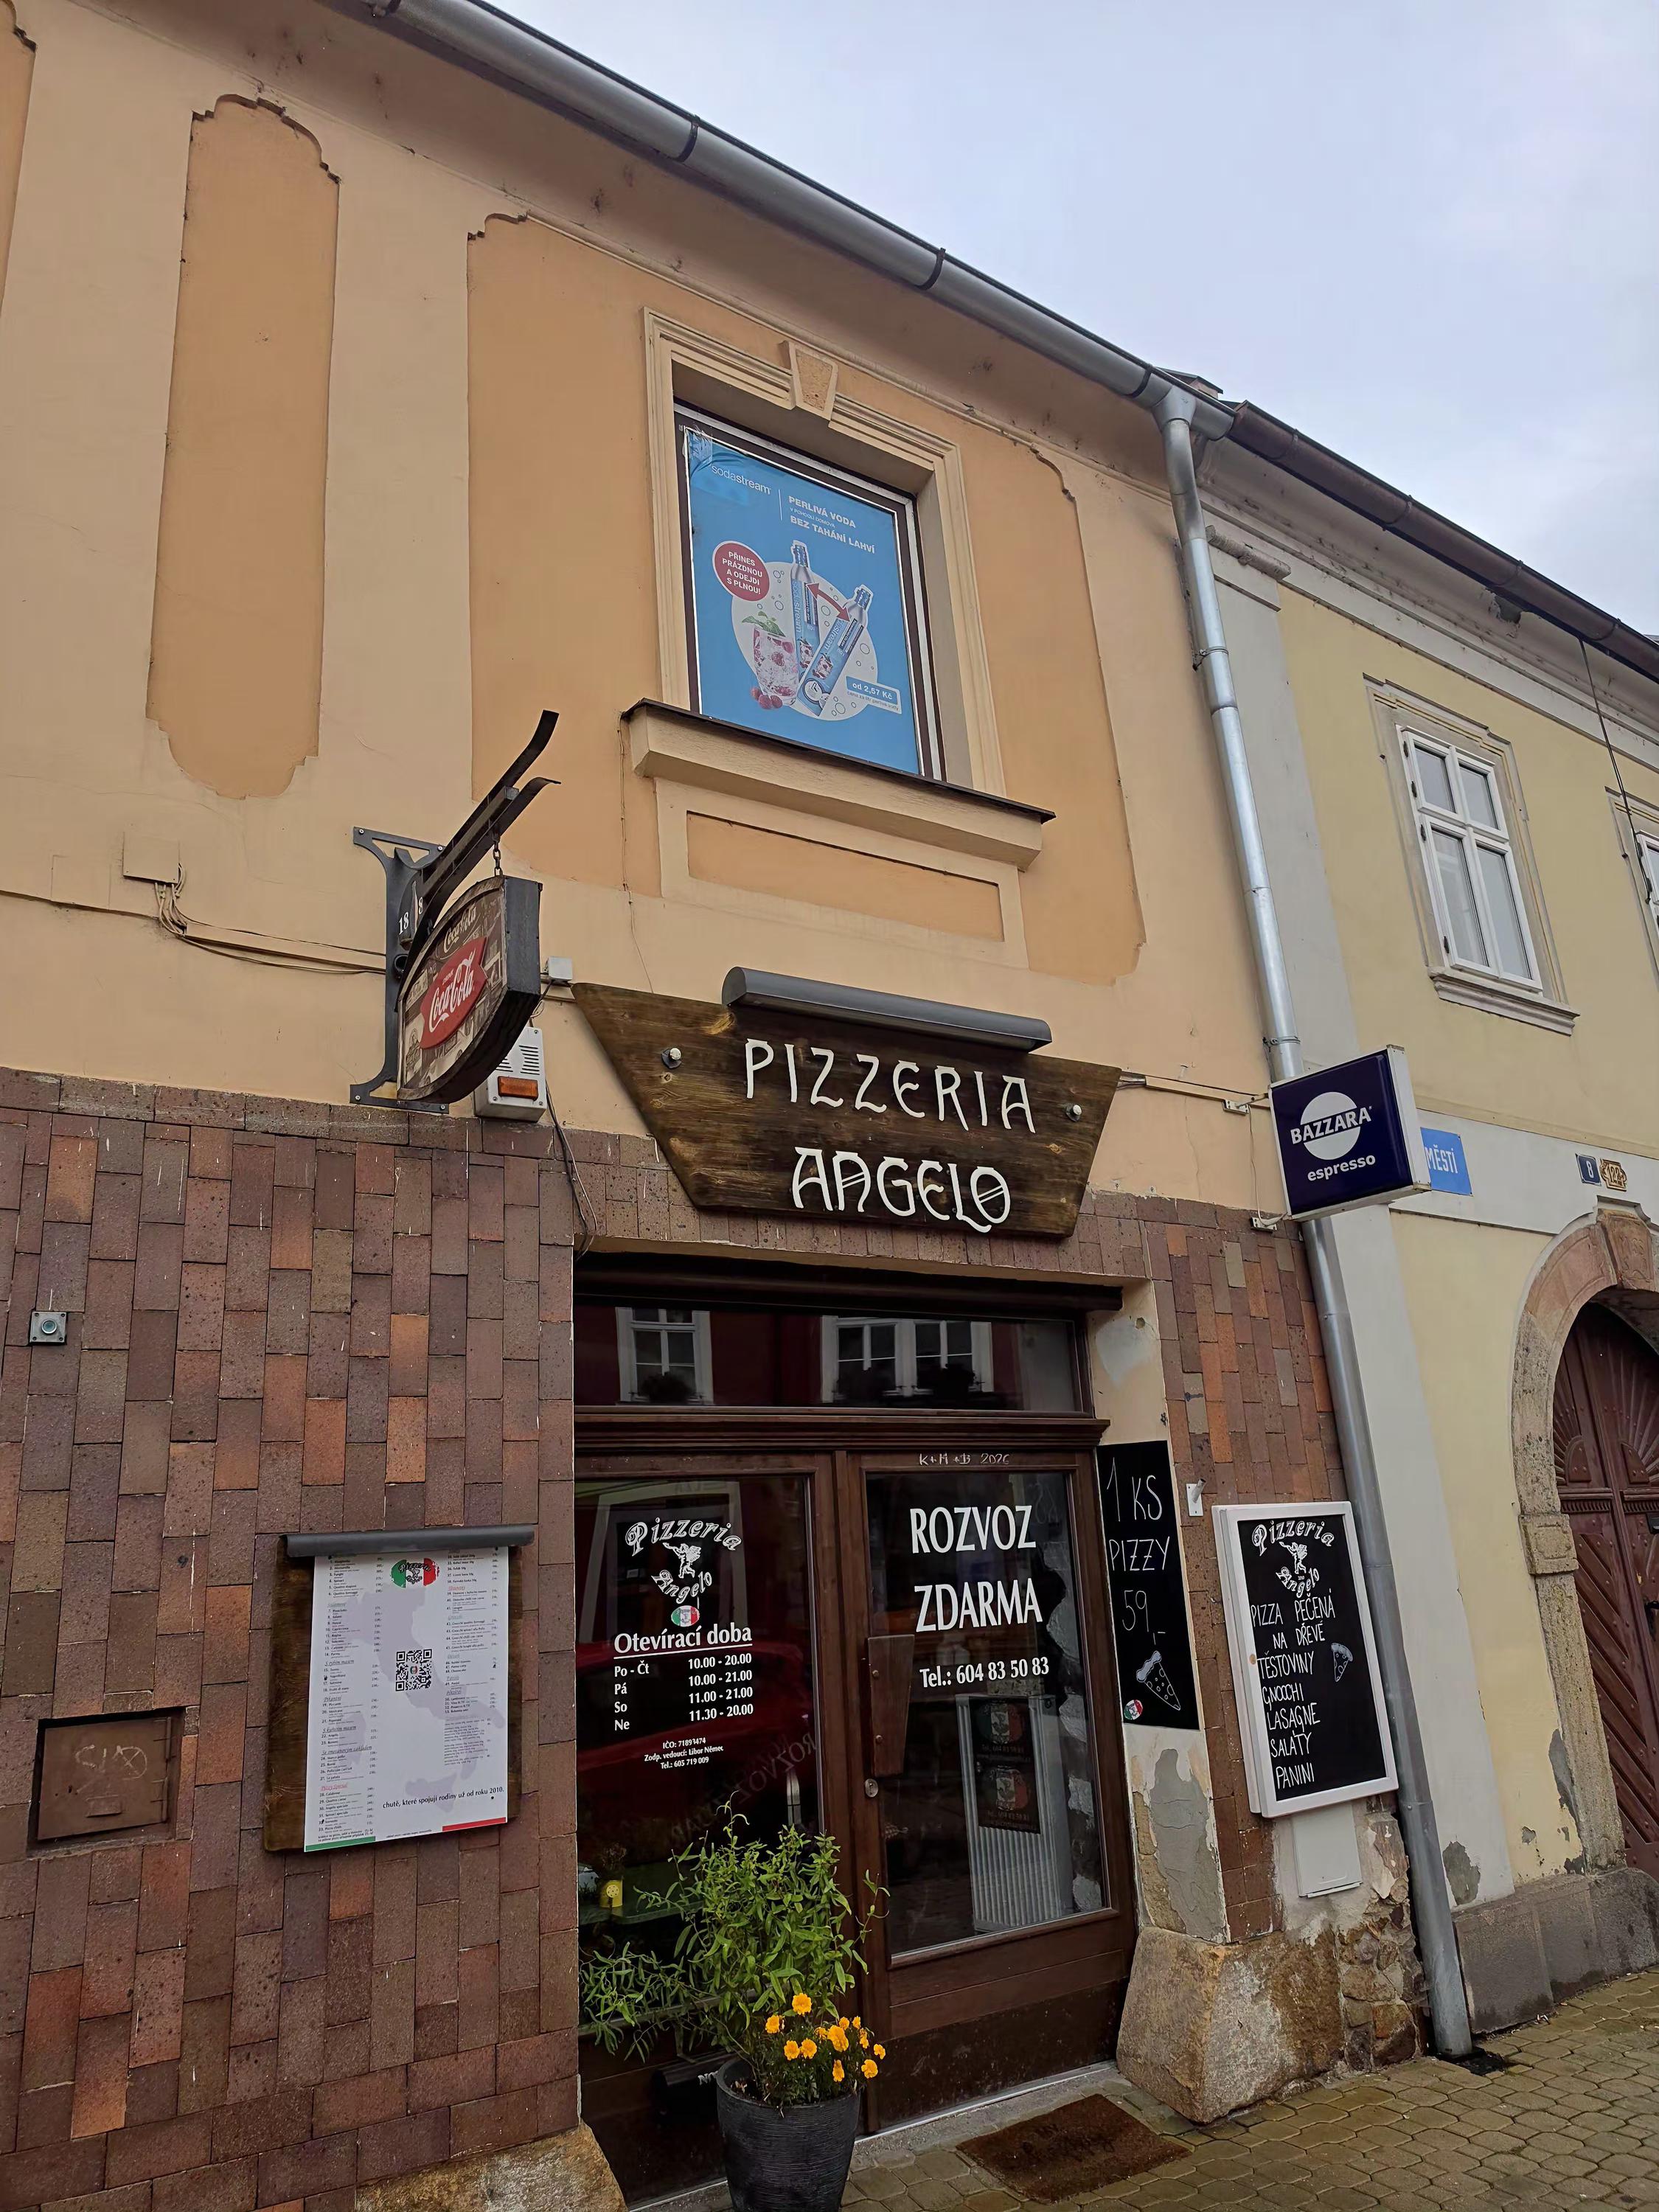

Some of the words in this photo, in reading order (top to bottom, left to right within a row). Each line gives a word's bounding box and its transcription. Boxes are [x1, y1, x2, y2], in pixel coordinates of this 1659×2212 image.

[712, 465, 771, 495] sodastream
[788, 495, 827, 517] PERLIVÁ
[830, 512, 855, 528] VODA
[790, 515, 810, 529] BEZ
[812, 523, 846, 543] TAHÁNÍ
[849, 538, 875, 553] LAHVÍ
[723, 558, 762, 577] PRÁZDNOU
[728, 552, 756, 566] PŘINES
[734, 571, 759, 585] ODEJDI
[734, 580, 760, 594] PLNOU!
[882, 691, 892, 700] Kč
[429, 947, 476, 1032] Coca-Cola
[745, 1038, 1035, 1133] PIZZERIA
[1290, 1107, 1371, 1144] BAZZARA
[1307, 1155, 1376, 1181] espresso
[1585, 1161, 1594, 1178] 8
[791, 1146, 1011, 1233] ANGELO
[980, 1453, 1010, 1465] 2026
[1107, 1456, 1120, 1522] 1
[1132, 1475, 1163, 1520] KS
[625, 1517, 742, 1557] Pizzeria
[909, 1504, 1037, 1554] ROZVOZ
[1251, 1520, 1335, 1557] Pizzeria
[1109, 1536, 1170, 1571] PIZZY
[650, 1569, 712, 1604] Angelo
[1276, 1566, 1320, 1599] Angelo
[914, 1578, 1043, 1632] ZDARMA
[1251, 1602, 1284, 1628] PIZZA
[1294, 1587, 1336, 1622] PEČENÁ
[613, 1625, 702, 1654] Otevírací
[706, 1621, 752, 1645] doba
[1273, 1632, 1288, 1649] NA
[614, 1666, 627, 1677] Po
[637, 1660, 650, 1674] Čt
[688, 1656, 716, 1669] 10.00
[725, 1652, 752, 1666] 20.00
[919, 1665, 952, 1688] Tel.:
[956, 1663, 984, 1684] 604
[988, 1660, 1006, 1680] 83
[1010, 1658, 1028, 1678] 50
[1032, 1656, 1049, 1676] 83
[1256, 1650, 1314, 1680] TĚSTOVINY
[614, 1682, 627, 1695] Pá
[688, 1673, 716, 1687] 10.00
[725, 1669, 753, 1683] 21.00
[614, 1701, 627, 1714] So
[689, 1691, 717, 1704] 11.00
[726, 1686, 753, 1700] 21.00
[614, 1719, 630, 1731] Ne
[689, 1708, 717, 1722] 11.30
[726, 1703, 754, 1717] 20.00
[1267, 1702, 1321, 1733] LASAGNE
[644, 1753, 662, 1762] Zodp.
[663, 1749, 687, 1759] vedoucí:
[689, 1747, 703, 1756] Libor
[704, 1745, 724, 1753] Němec
[662, 1740, 677, 1749] IČO:
[1270, 1730, 1312, 1758] SALÁTY
[661, 1761, 673, 1769] Tel.:
[674, 1759, 685, 1767] 605
[686, 1758, 698, 1766] 719
[698, 1756, 709, 1764] 009
[1276, 1761, 1315, 1790] PANINI
[383, 1801, 401, 1809] chutě,
[418, 1795, 438, 1804] spojují
[439, 1794, 457, 1802] rodiny
[475, 1788, 488, 1796] roku
